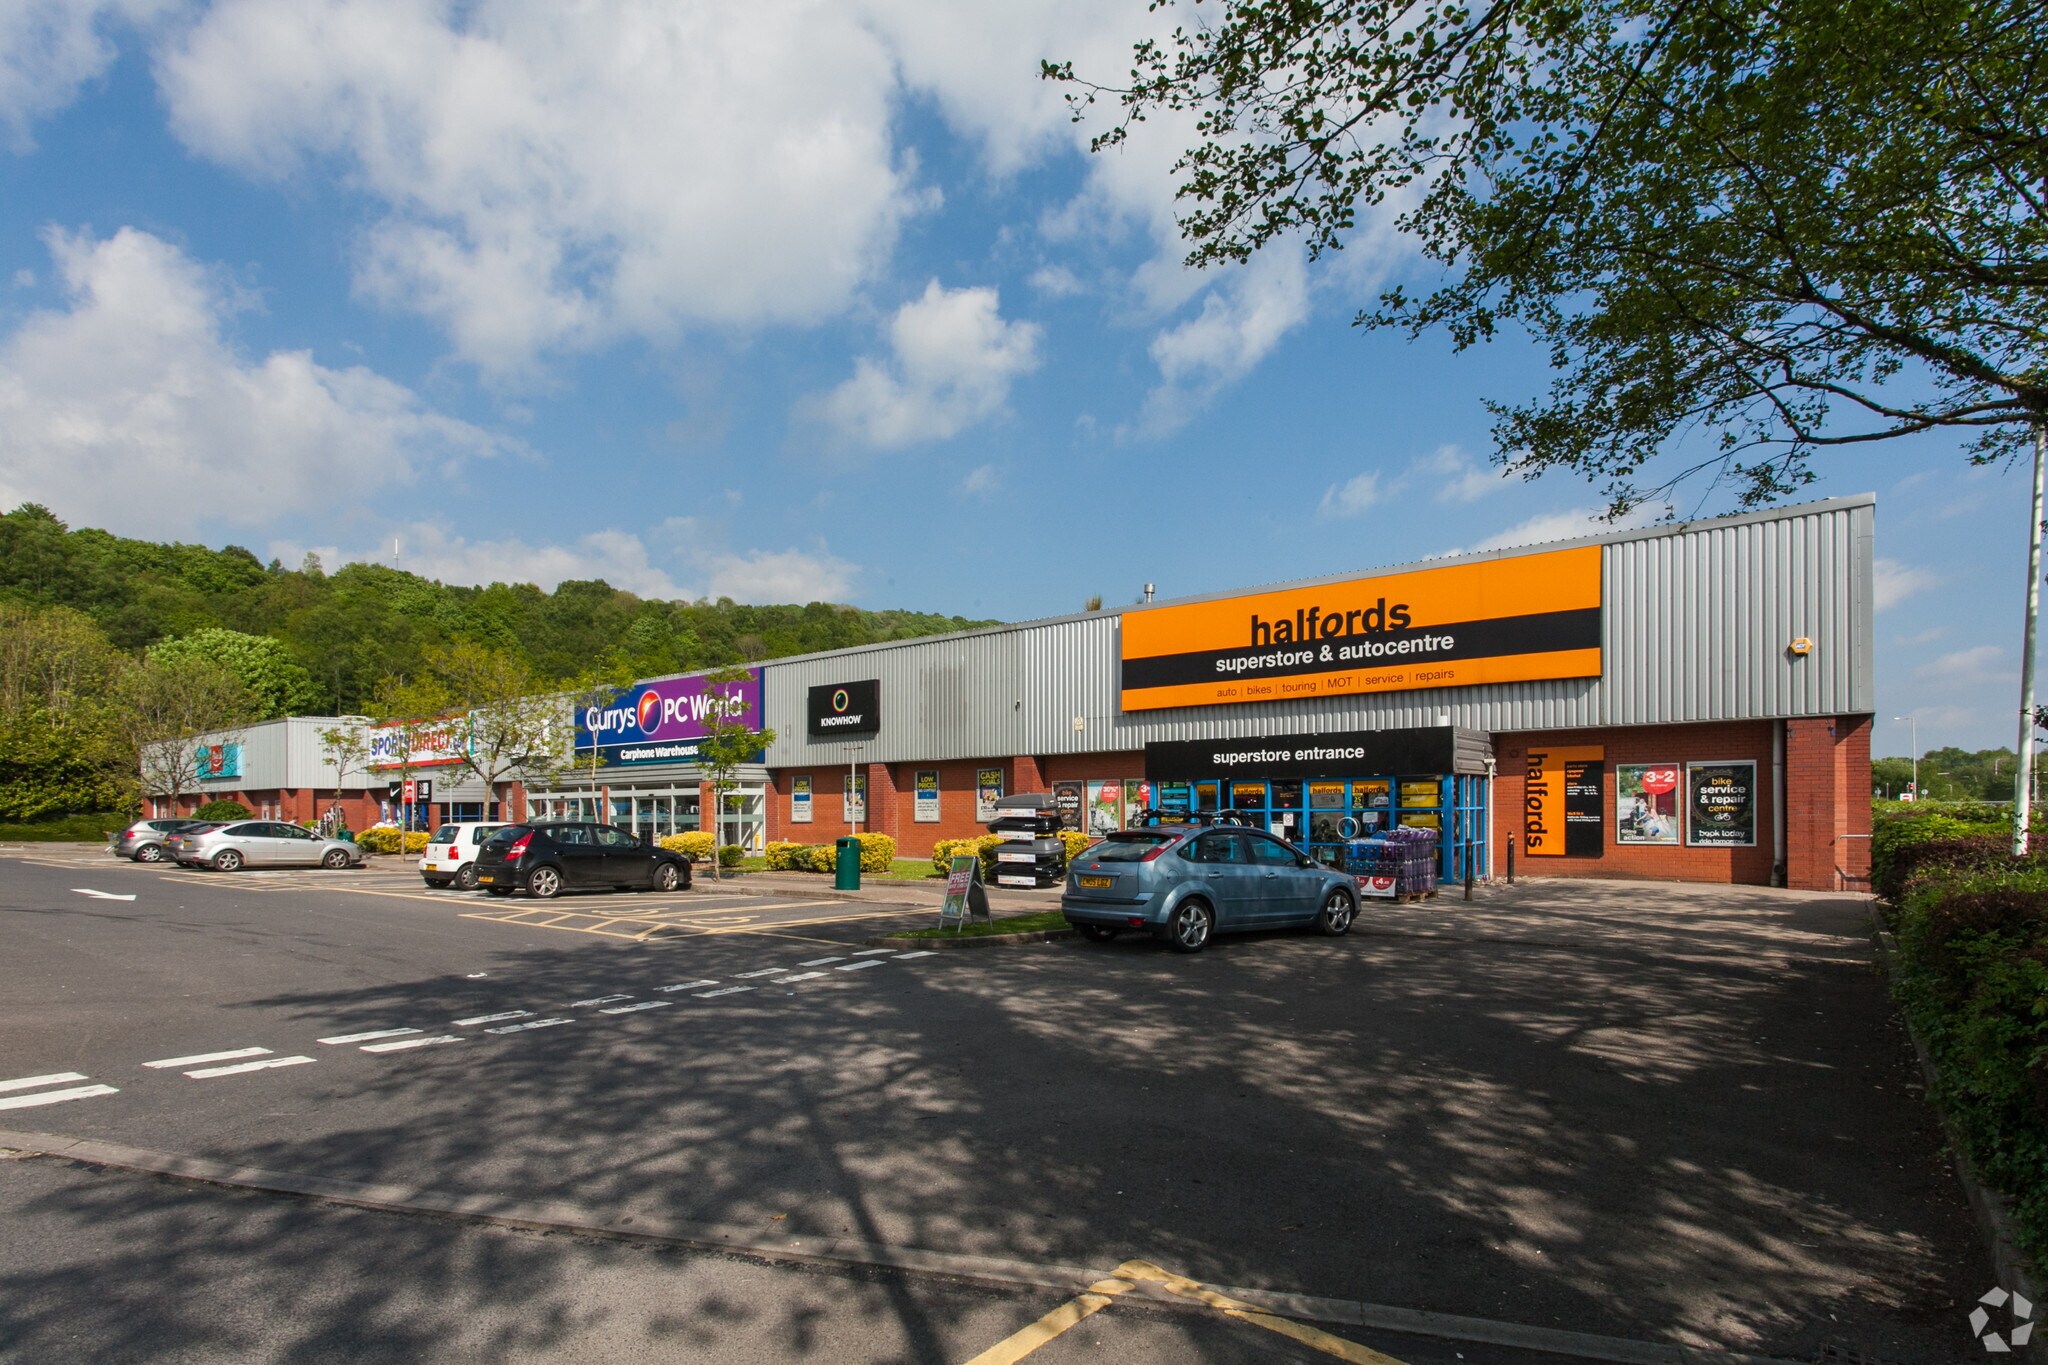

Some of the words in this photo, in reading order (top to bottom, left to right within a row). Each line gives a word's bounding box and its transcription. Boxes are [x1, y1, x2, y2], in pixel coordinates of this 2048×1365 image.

[1251, 598, 1411, 646] halfords
[1216, 649, 1314, 674] superstore
[1319, 645, 1334, 662] &
[1339, 634, 1455, 659] autocentre
[1216, 688, 1237, 697] auto
[1247, 685, 1272, 695] bikes
[1282, 681, 1317, 692] touring
[1327, 676, 1353, 688] MOT
[1365, 673, 1404, 685] service
[1415, 669, 1455, 682] repairs
[586, 706, 636, 734] Currys
[664, 696, 688, 724] PC
[690, 689, 743, 722] World
[820, 714, 863, 727] KNOWHOW
[620, 748, 655, 761] Carphone
[655, 745, 699, 759] Warehouse
[1213, 749, 1291, 766] superstore
[1295, 747, 1365, 761] entrance
[980, 771, 1001, 779] CASH
[1645, 771, 1656, 783] 3
[1664, 770, 1675, 782] 2
[847, 777, 864, 785] CSH
[1711, 777, 1733, 786] bike
[1235, 787, 1263, 795] halfords
[1354, 785, 1386, 793] halfords
[1700, 785, 1746, 794] service
[1062, 801, 1079, 809] repair
[1527, 753, 1549, 848] halfords
[1700, 795, 1709, 804] &
[1711, 794, 1746, 805] repair
[1698, 829, 1720, 837] book
[1722, 829, 1745, 838] today
[950, 872, 970, 883] FREE
